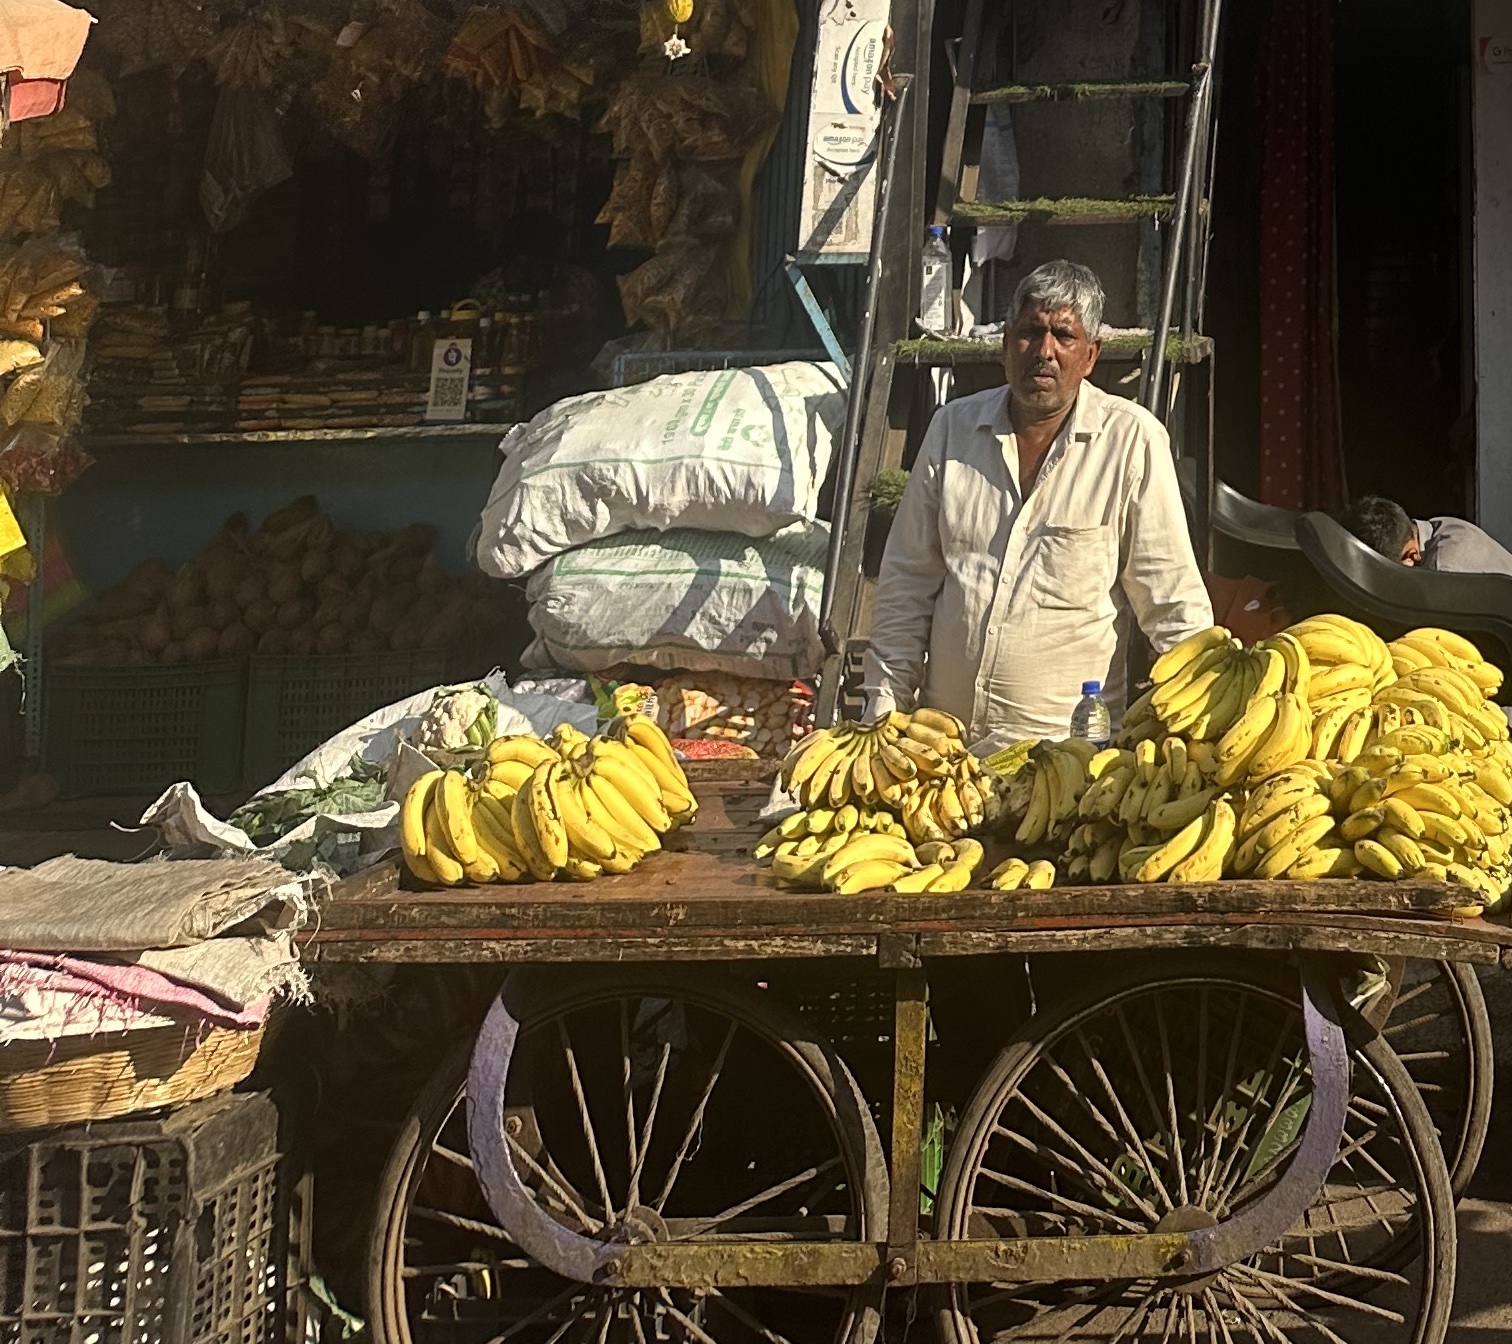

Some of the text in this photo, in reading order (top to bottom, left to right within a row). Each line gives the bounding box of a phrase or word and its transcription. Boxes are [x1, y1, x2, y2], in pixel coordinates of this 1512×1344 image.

[834, 45, 842, 62] Scan
[1492, 46, 1503, 56] G
[861, 38, 876, 96] amazon pay
[823, 136, 852, 145] amazon
